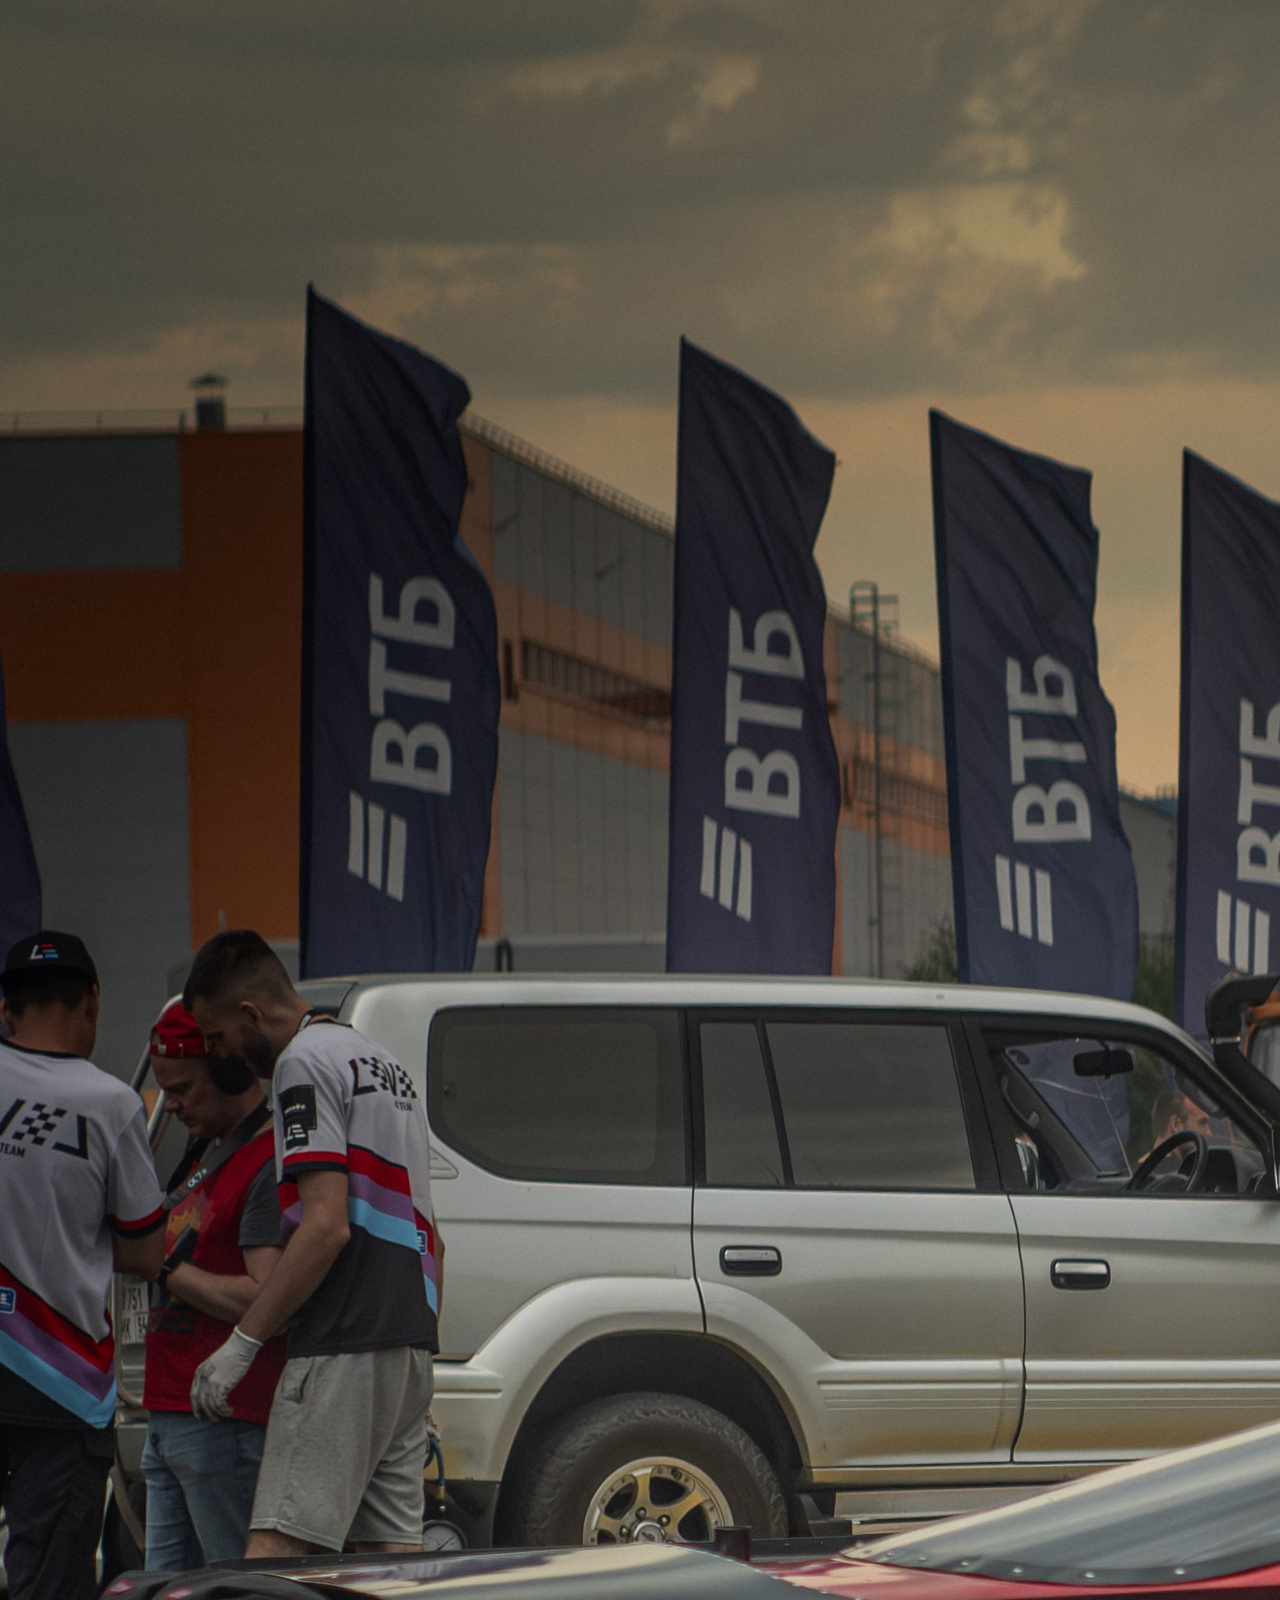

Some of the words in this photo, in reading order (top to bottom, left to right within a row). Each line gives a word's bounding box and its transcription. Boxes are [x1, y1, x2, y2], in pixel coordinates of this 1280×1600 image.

[368, 571, 457, 796] ВТБ
[723, 606, 806, 820] ВТБ
[1005, 653, 1093, 844] ВТБ
